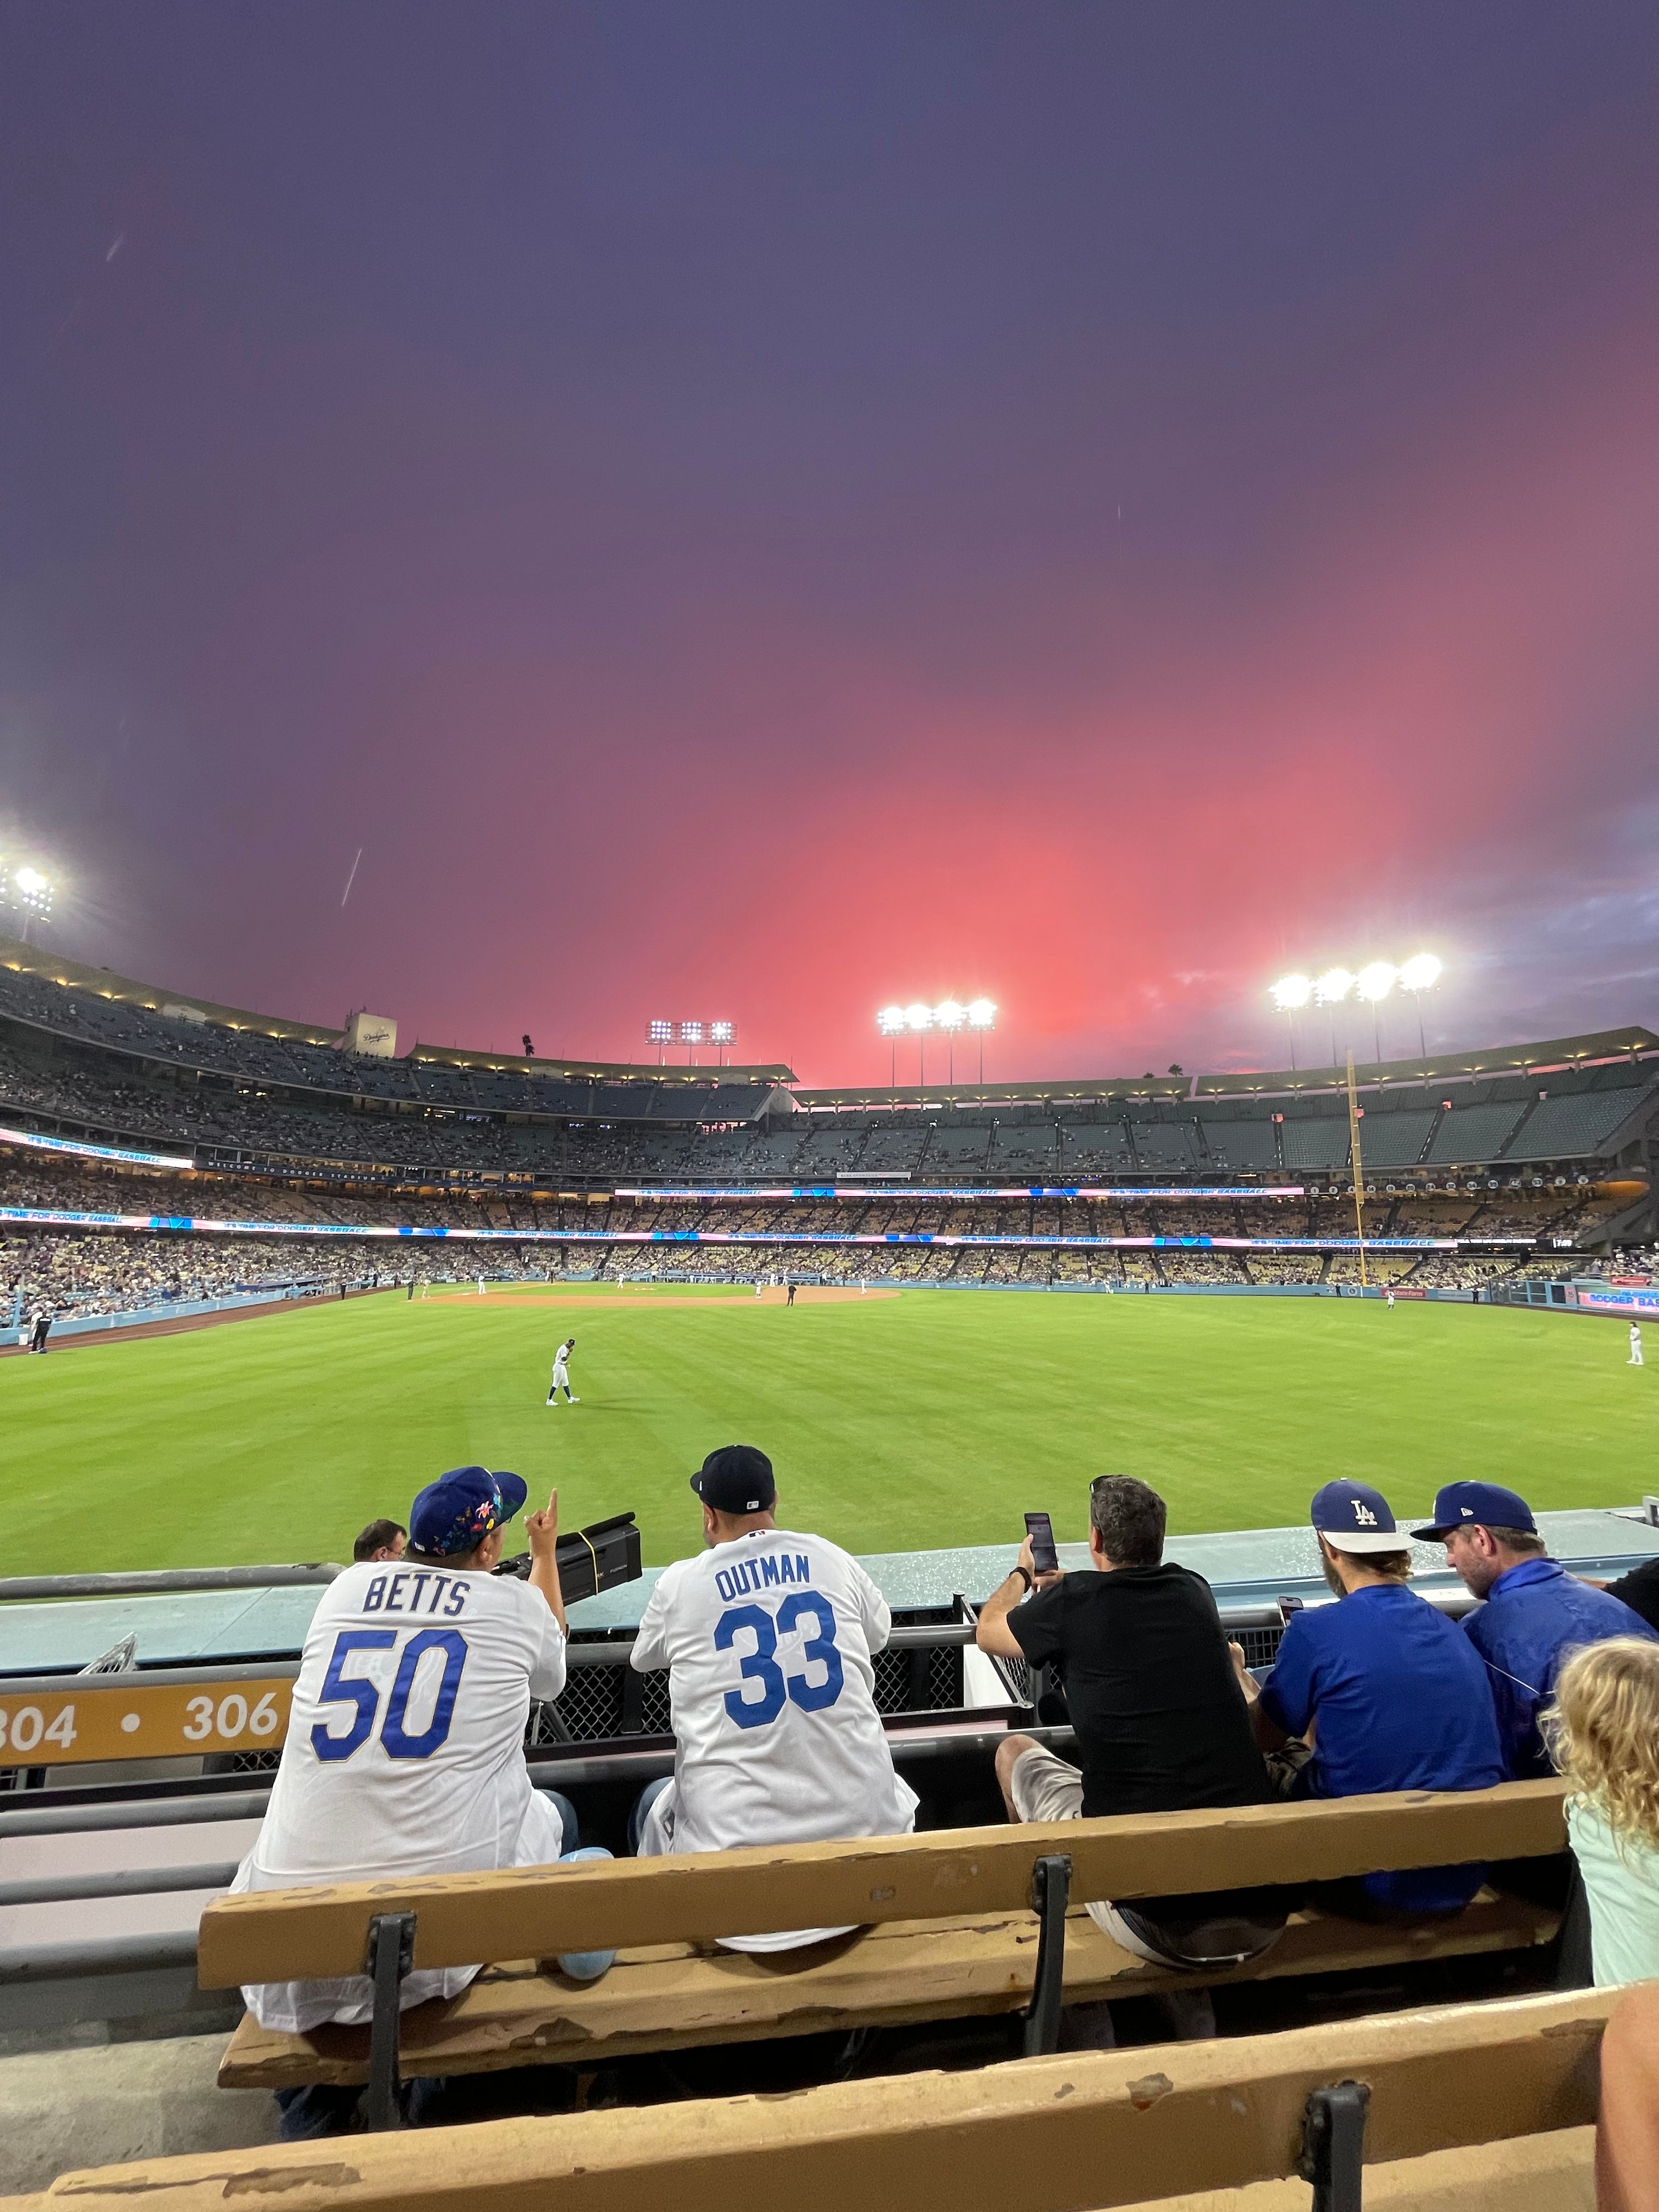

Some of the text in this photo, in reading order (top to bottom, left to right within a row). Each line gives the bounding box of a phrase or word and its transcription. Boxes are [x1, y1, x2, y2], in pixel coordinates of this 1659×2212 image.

[43, 1137, 63, 1147] TIME
[65, 1142, 81, 1151] FOR
[83, 1146, 117, 1156] DODGER
[118, 1151, 160, 1163] BASEBALL
[208, 1161, 256, 1171] WELCOME
[331, 1173, 376, 1181] STADIUM
[88, 1215, 123, 1223] BASEBALL
[1590, 1294, 1634, 1305] DODGER
[1350, 1500, 1378, 1525] LA
[362, 1572, 471, 1617] BETTS
[714, 1554, 810, 1603] OUTMAN
[713, 1589, 844, 1730] 33
[310, 1627, 469, 1764] 50
[0, 1692, 278, 1751] 04 306
